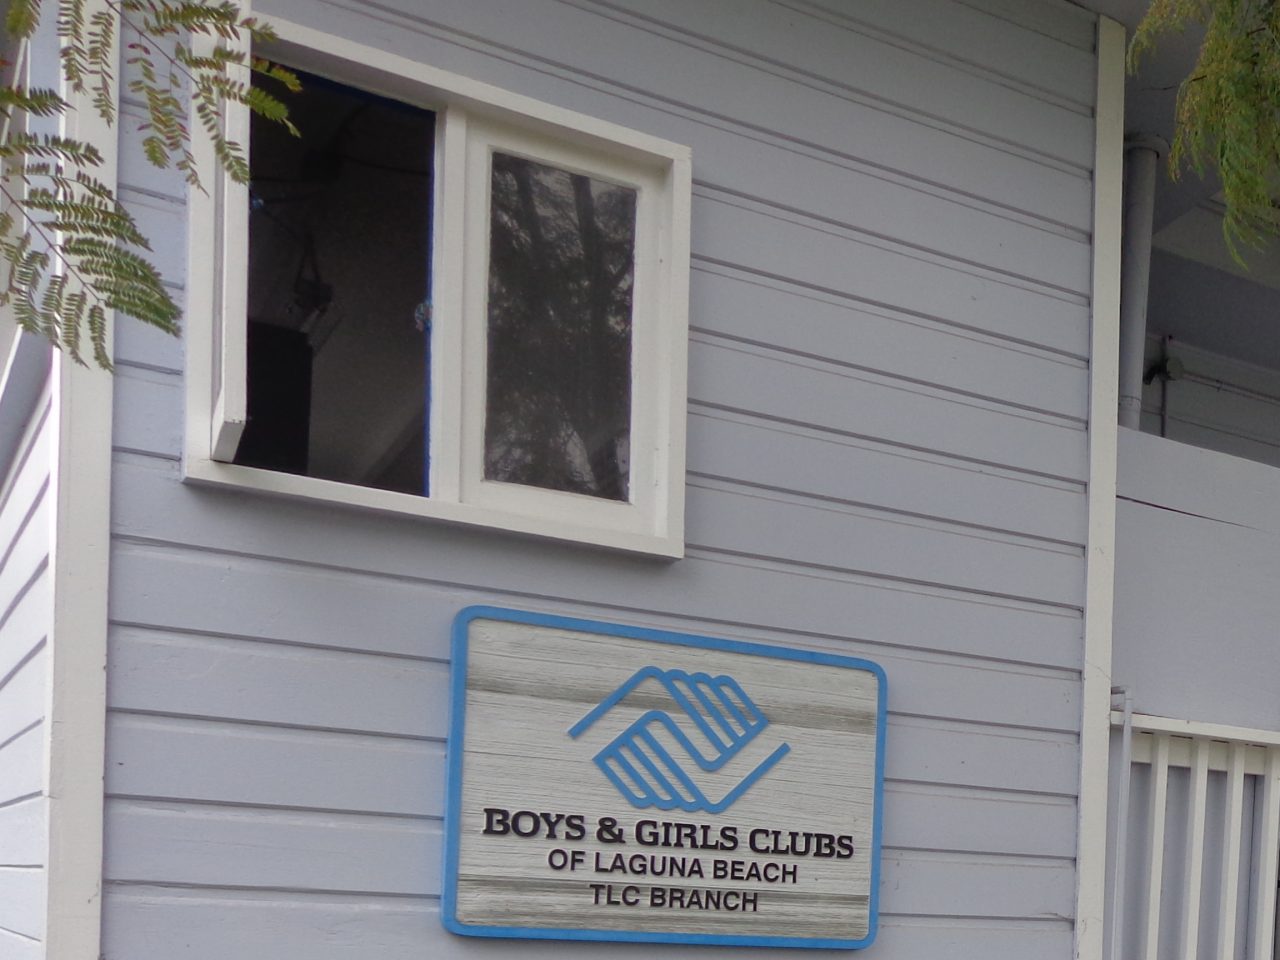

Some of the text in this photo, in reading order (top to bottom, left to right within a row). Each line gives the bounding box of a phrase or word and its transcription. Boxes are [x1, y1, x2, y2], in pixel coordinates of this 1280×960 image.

[483, 808, 854, 859] BOYS & GIRLS CLUBS
[548, 849, 797, 884] OF LAGUNA BEACH
[589, 884, 758, 912] TLC BRANCH
